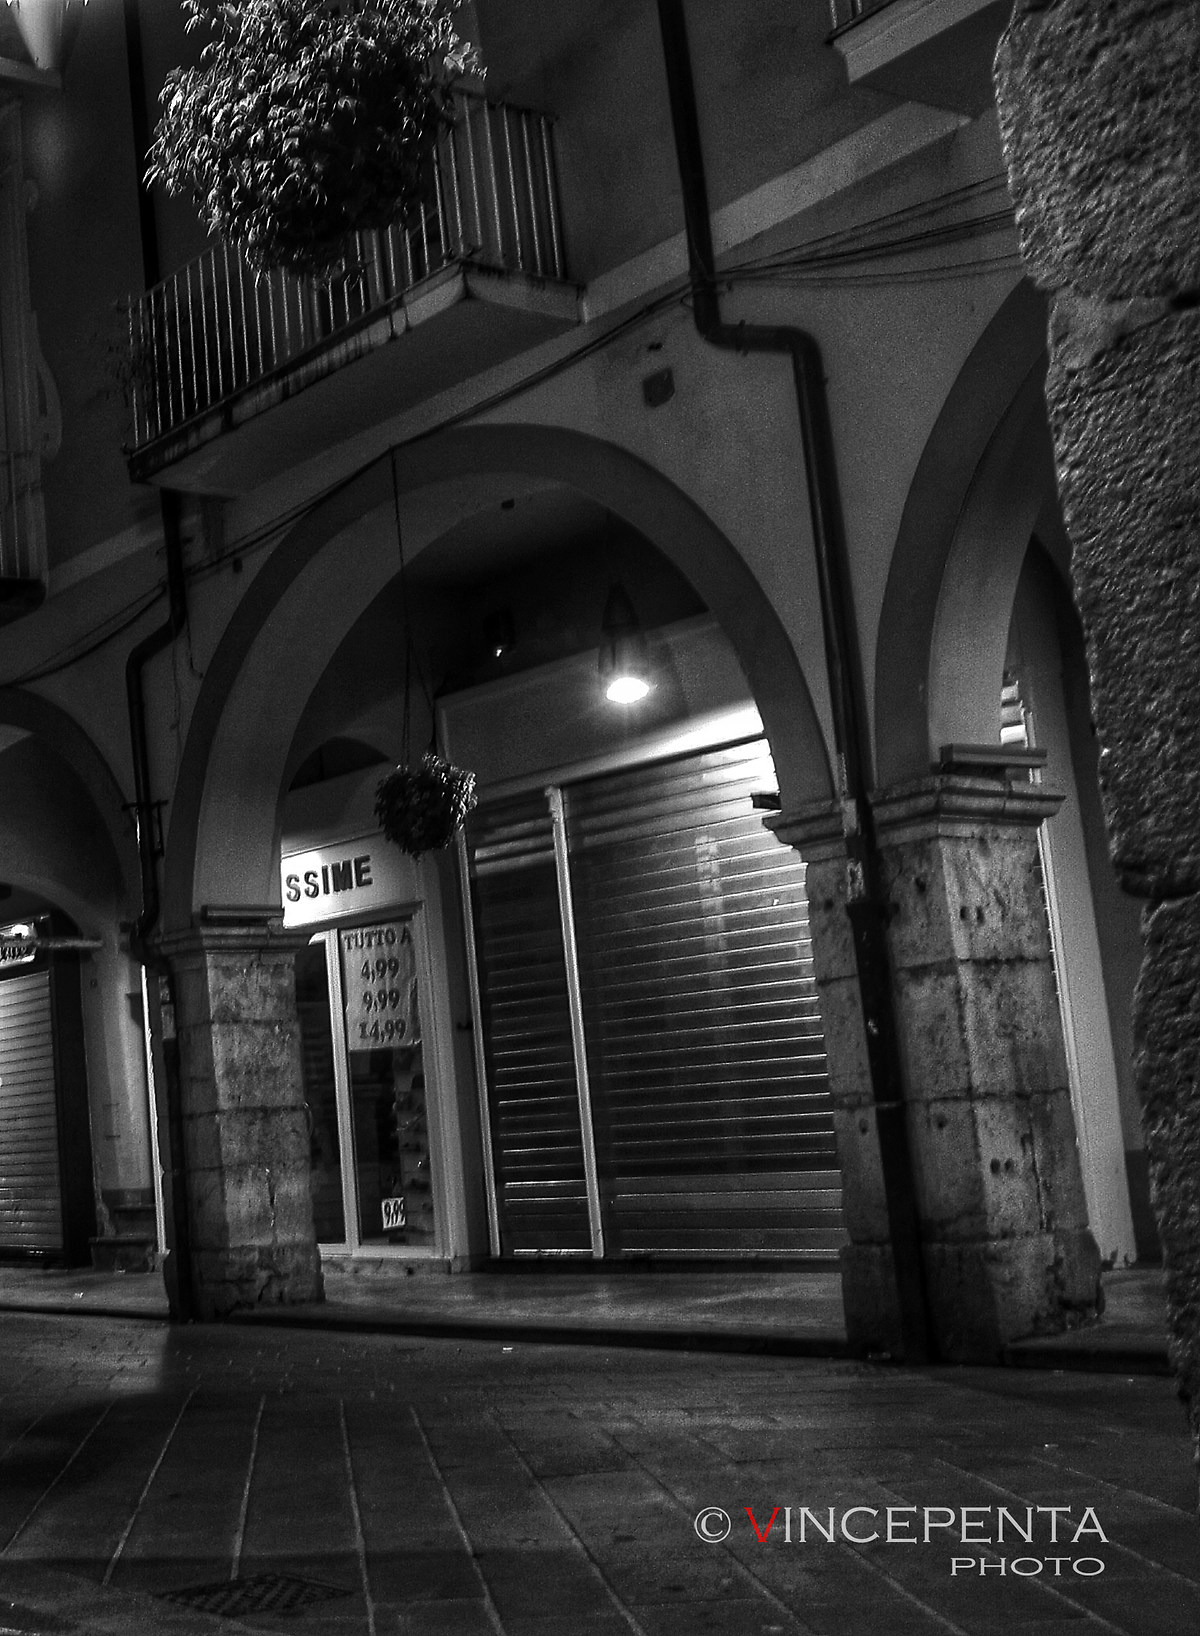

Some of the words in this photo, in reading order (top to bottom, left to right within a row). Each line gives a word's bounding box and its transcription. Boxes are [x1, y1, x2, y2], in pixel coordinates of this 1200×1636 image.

[285, 854, 374, 903] SSIME
[344, 927, 397, 950] TUTTO
[400, 926, 413, 945] A
[361, 958, 400, 985] 4,99
[362, 987, 400, 1014] 9,99
[359, 1019, 406, 1043] 14,99
